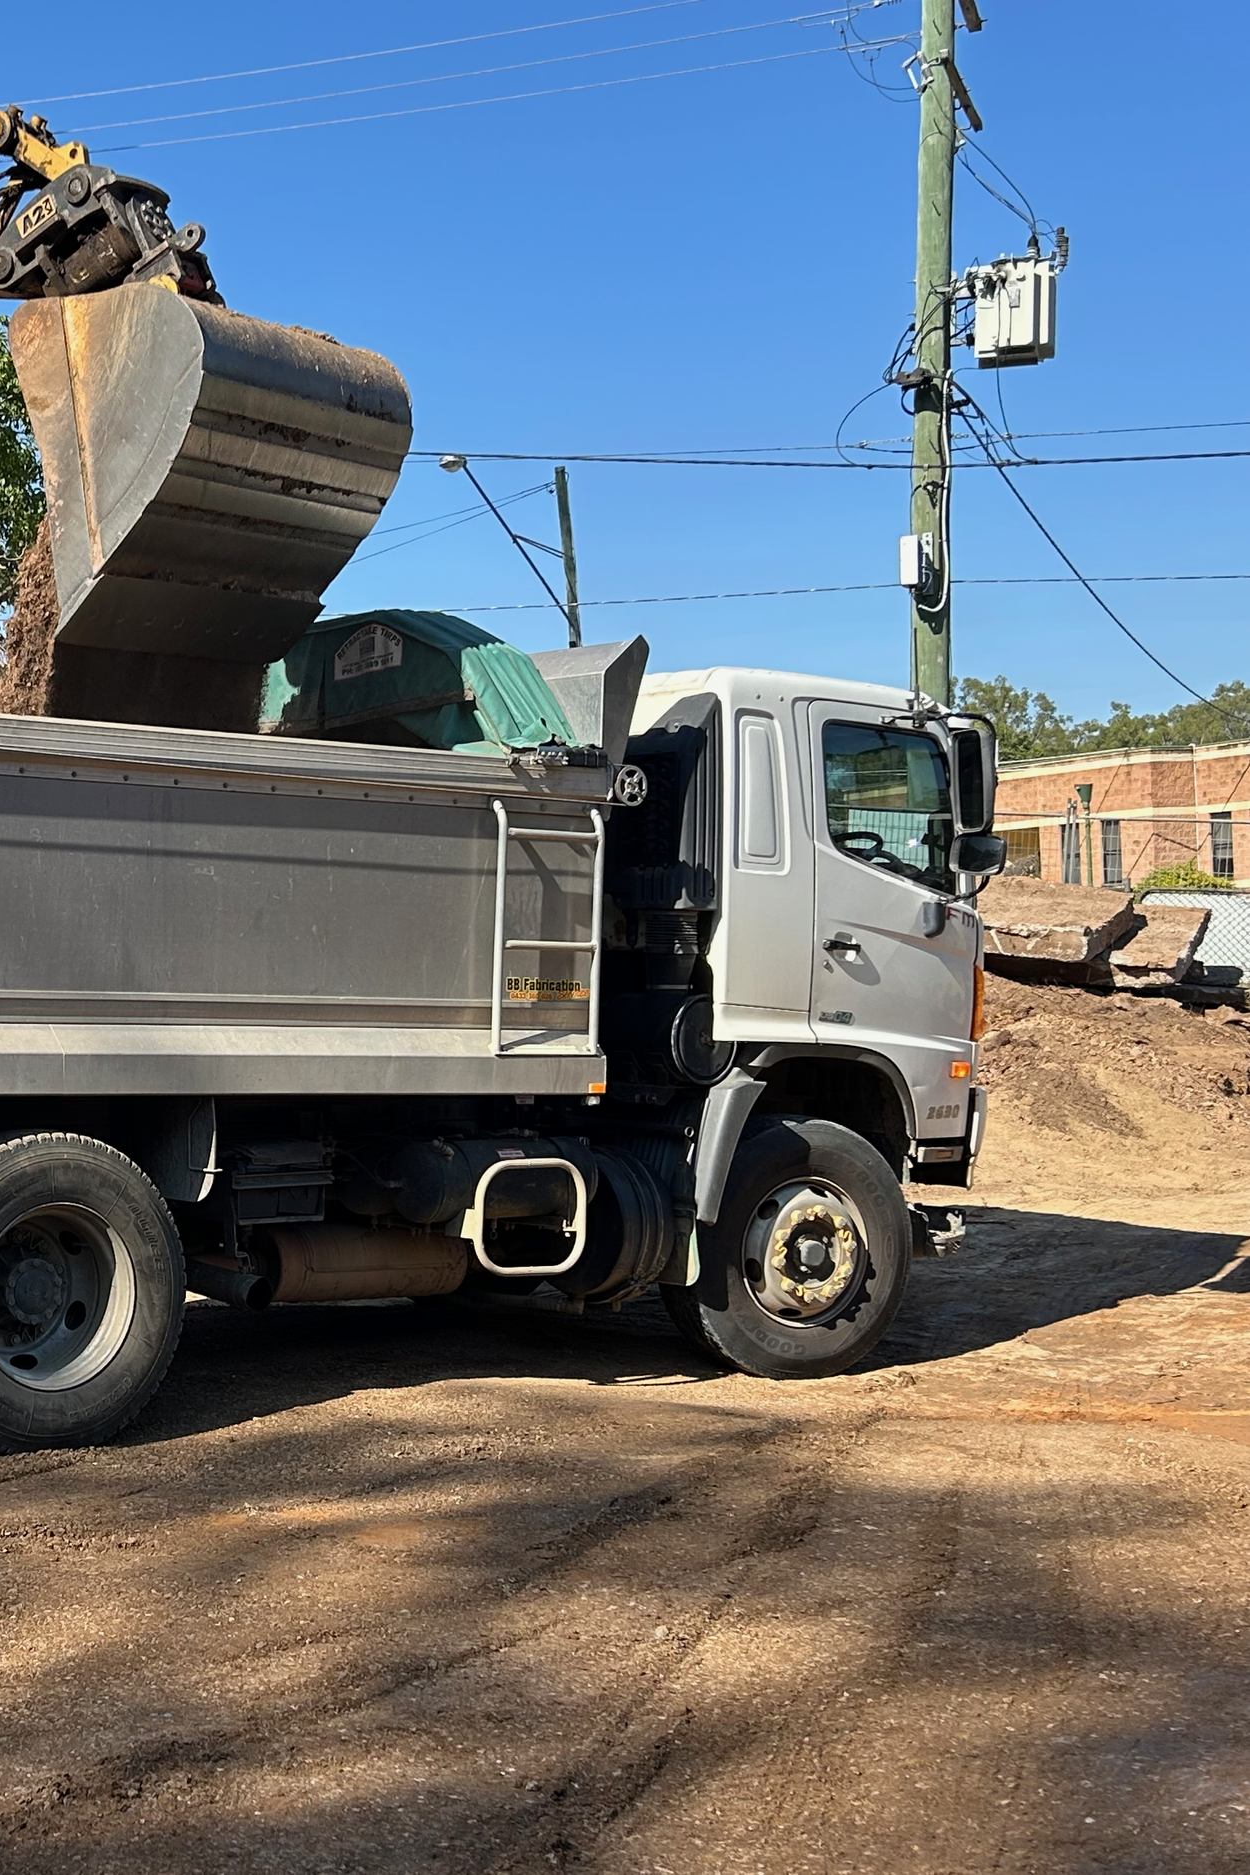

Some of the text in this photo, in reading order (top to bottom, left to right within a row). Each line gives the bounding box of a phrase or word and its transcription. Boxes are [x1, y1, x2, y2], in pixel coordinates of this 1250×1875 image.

[506, 977, 582, 992] BB Fabrication
[925, 1104, 960, 1120] 2630
